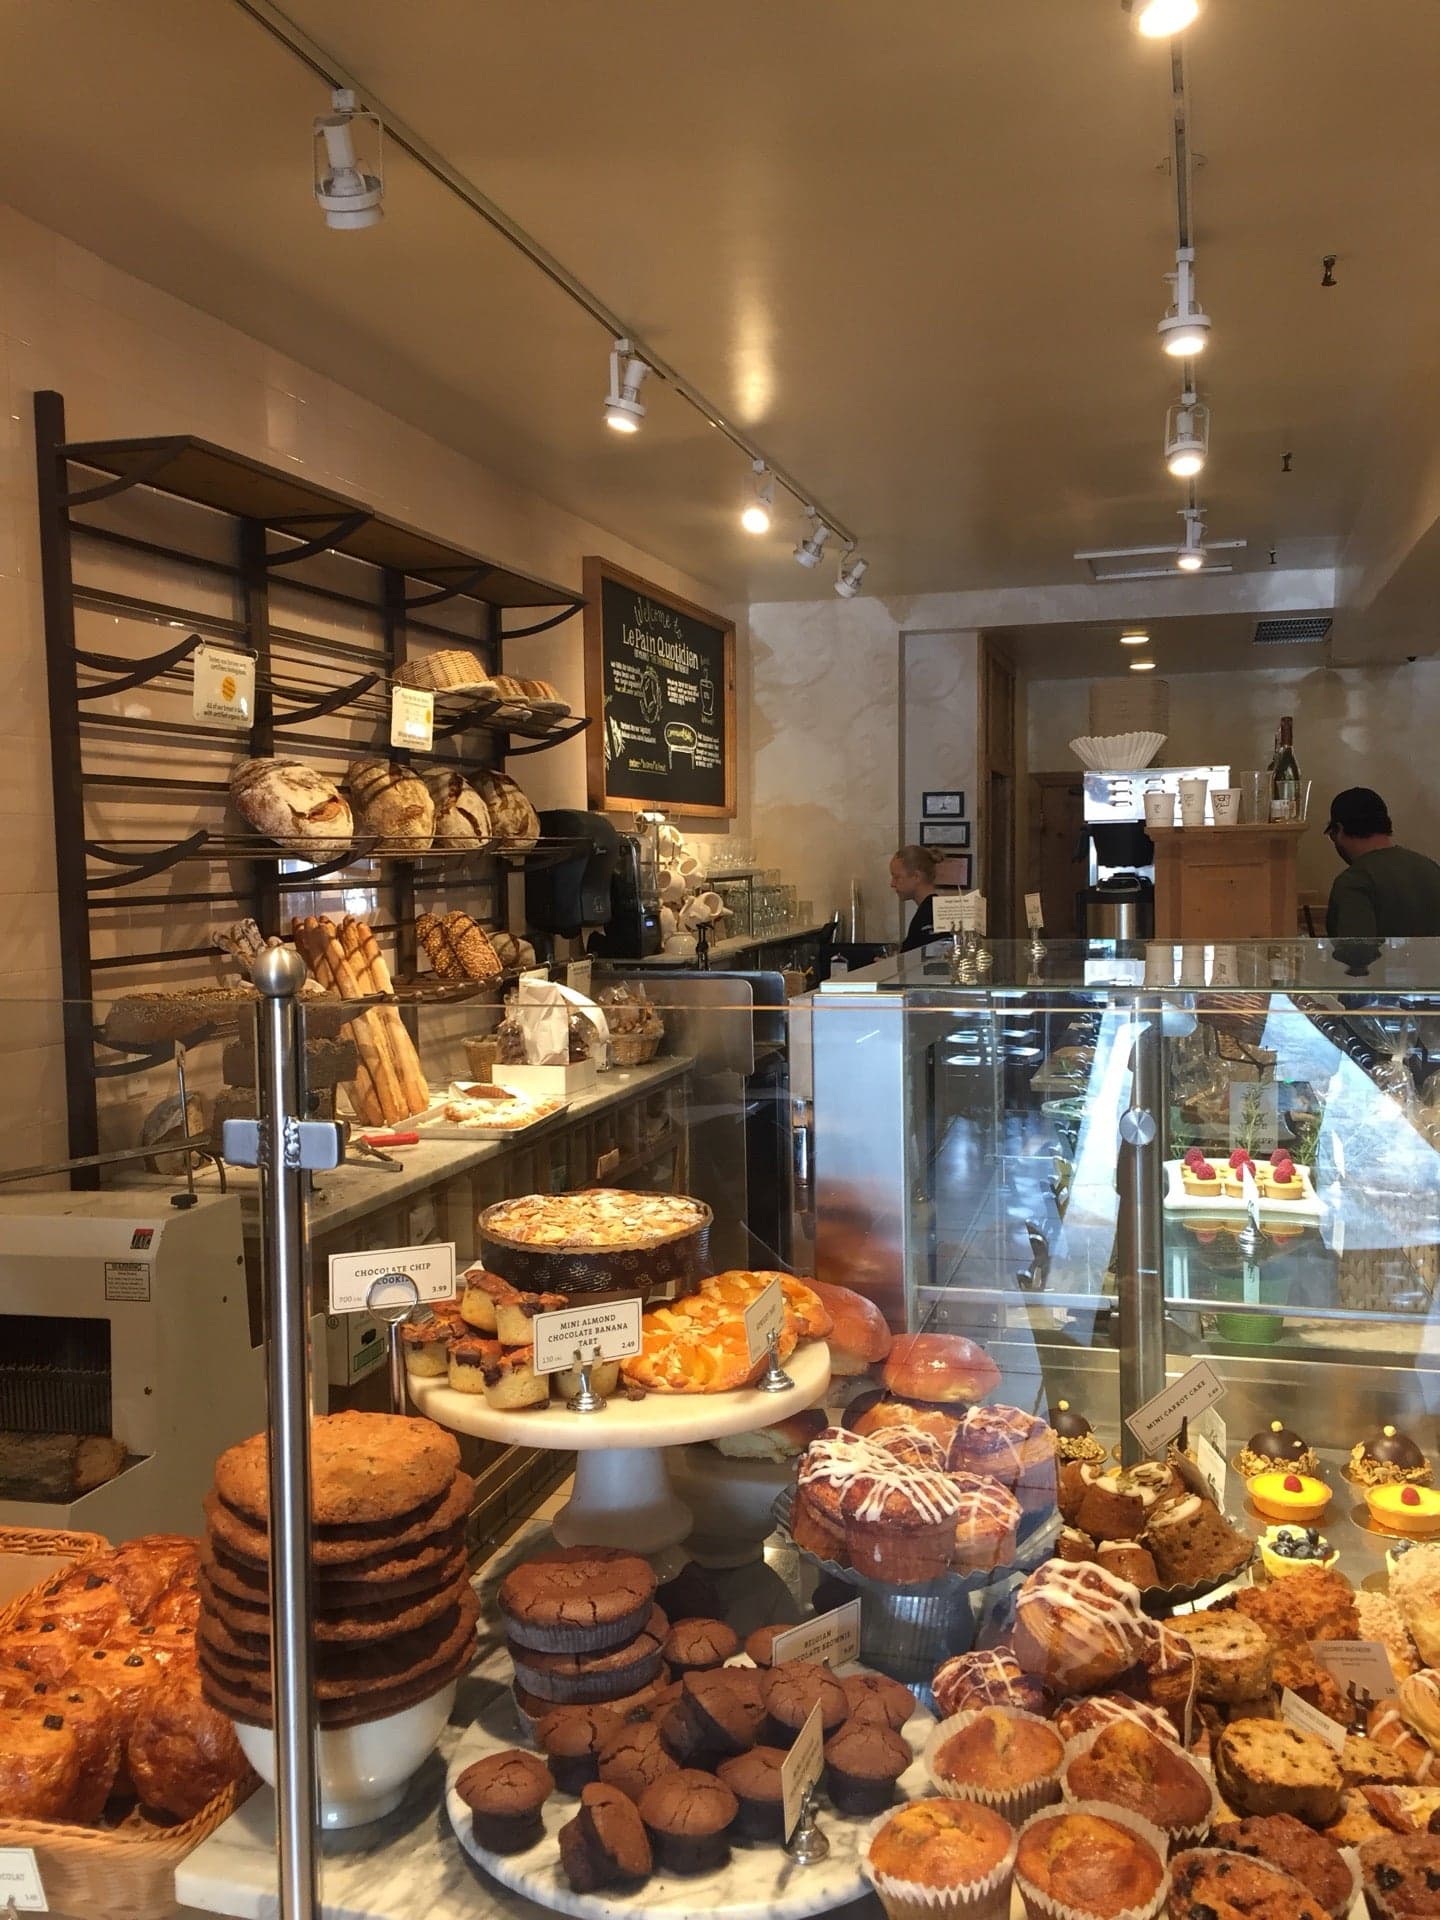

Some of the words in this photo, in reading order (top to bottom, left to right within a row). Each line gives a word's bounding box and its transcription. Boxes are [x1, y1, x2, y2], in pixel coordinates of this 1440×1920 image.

[622, 623, 635, 647] Le
[635, 628, 657, 655] Pain
[657, 636, 699, 671] Quotidien
[409, 1262, 431, 1272] CHIP
[376, 1275, 410, 1285] COOKI
[432, 1284, 447, 1293] 3.99
[560, 1319, 580, 1330] MINI
[582, 1314, 616, 1326] ALMOND
[548, 1328, 593, 1343] CHOCOLATE
[595, 1322, 628, 1334] BANANA
[578, 1337, 598, 1347] TART
[621, 1341, 635, 1349] 2.49
[1146, 1414, 1164, 1430] MINI
[1163, 1394, 1189, 1417] CARROT
[1189, 1380, 1206, 1396] CAKE
